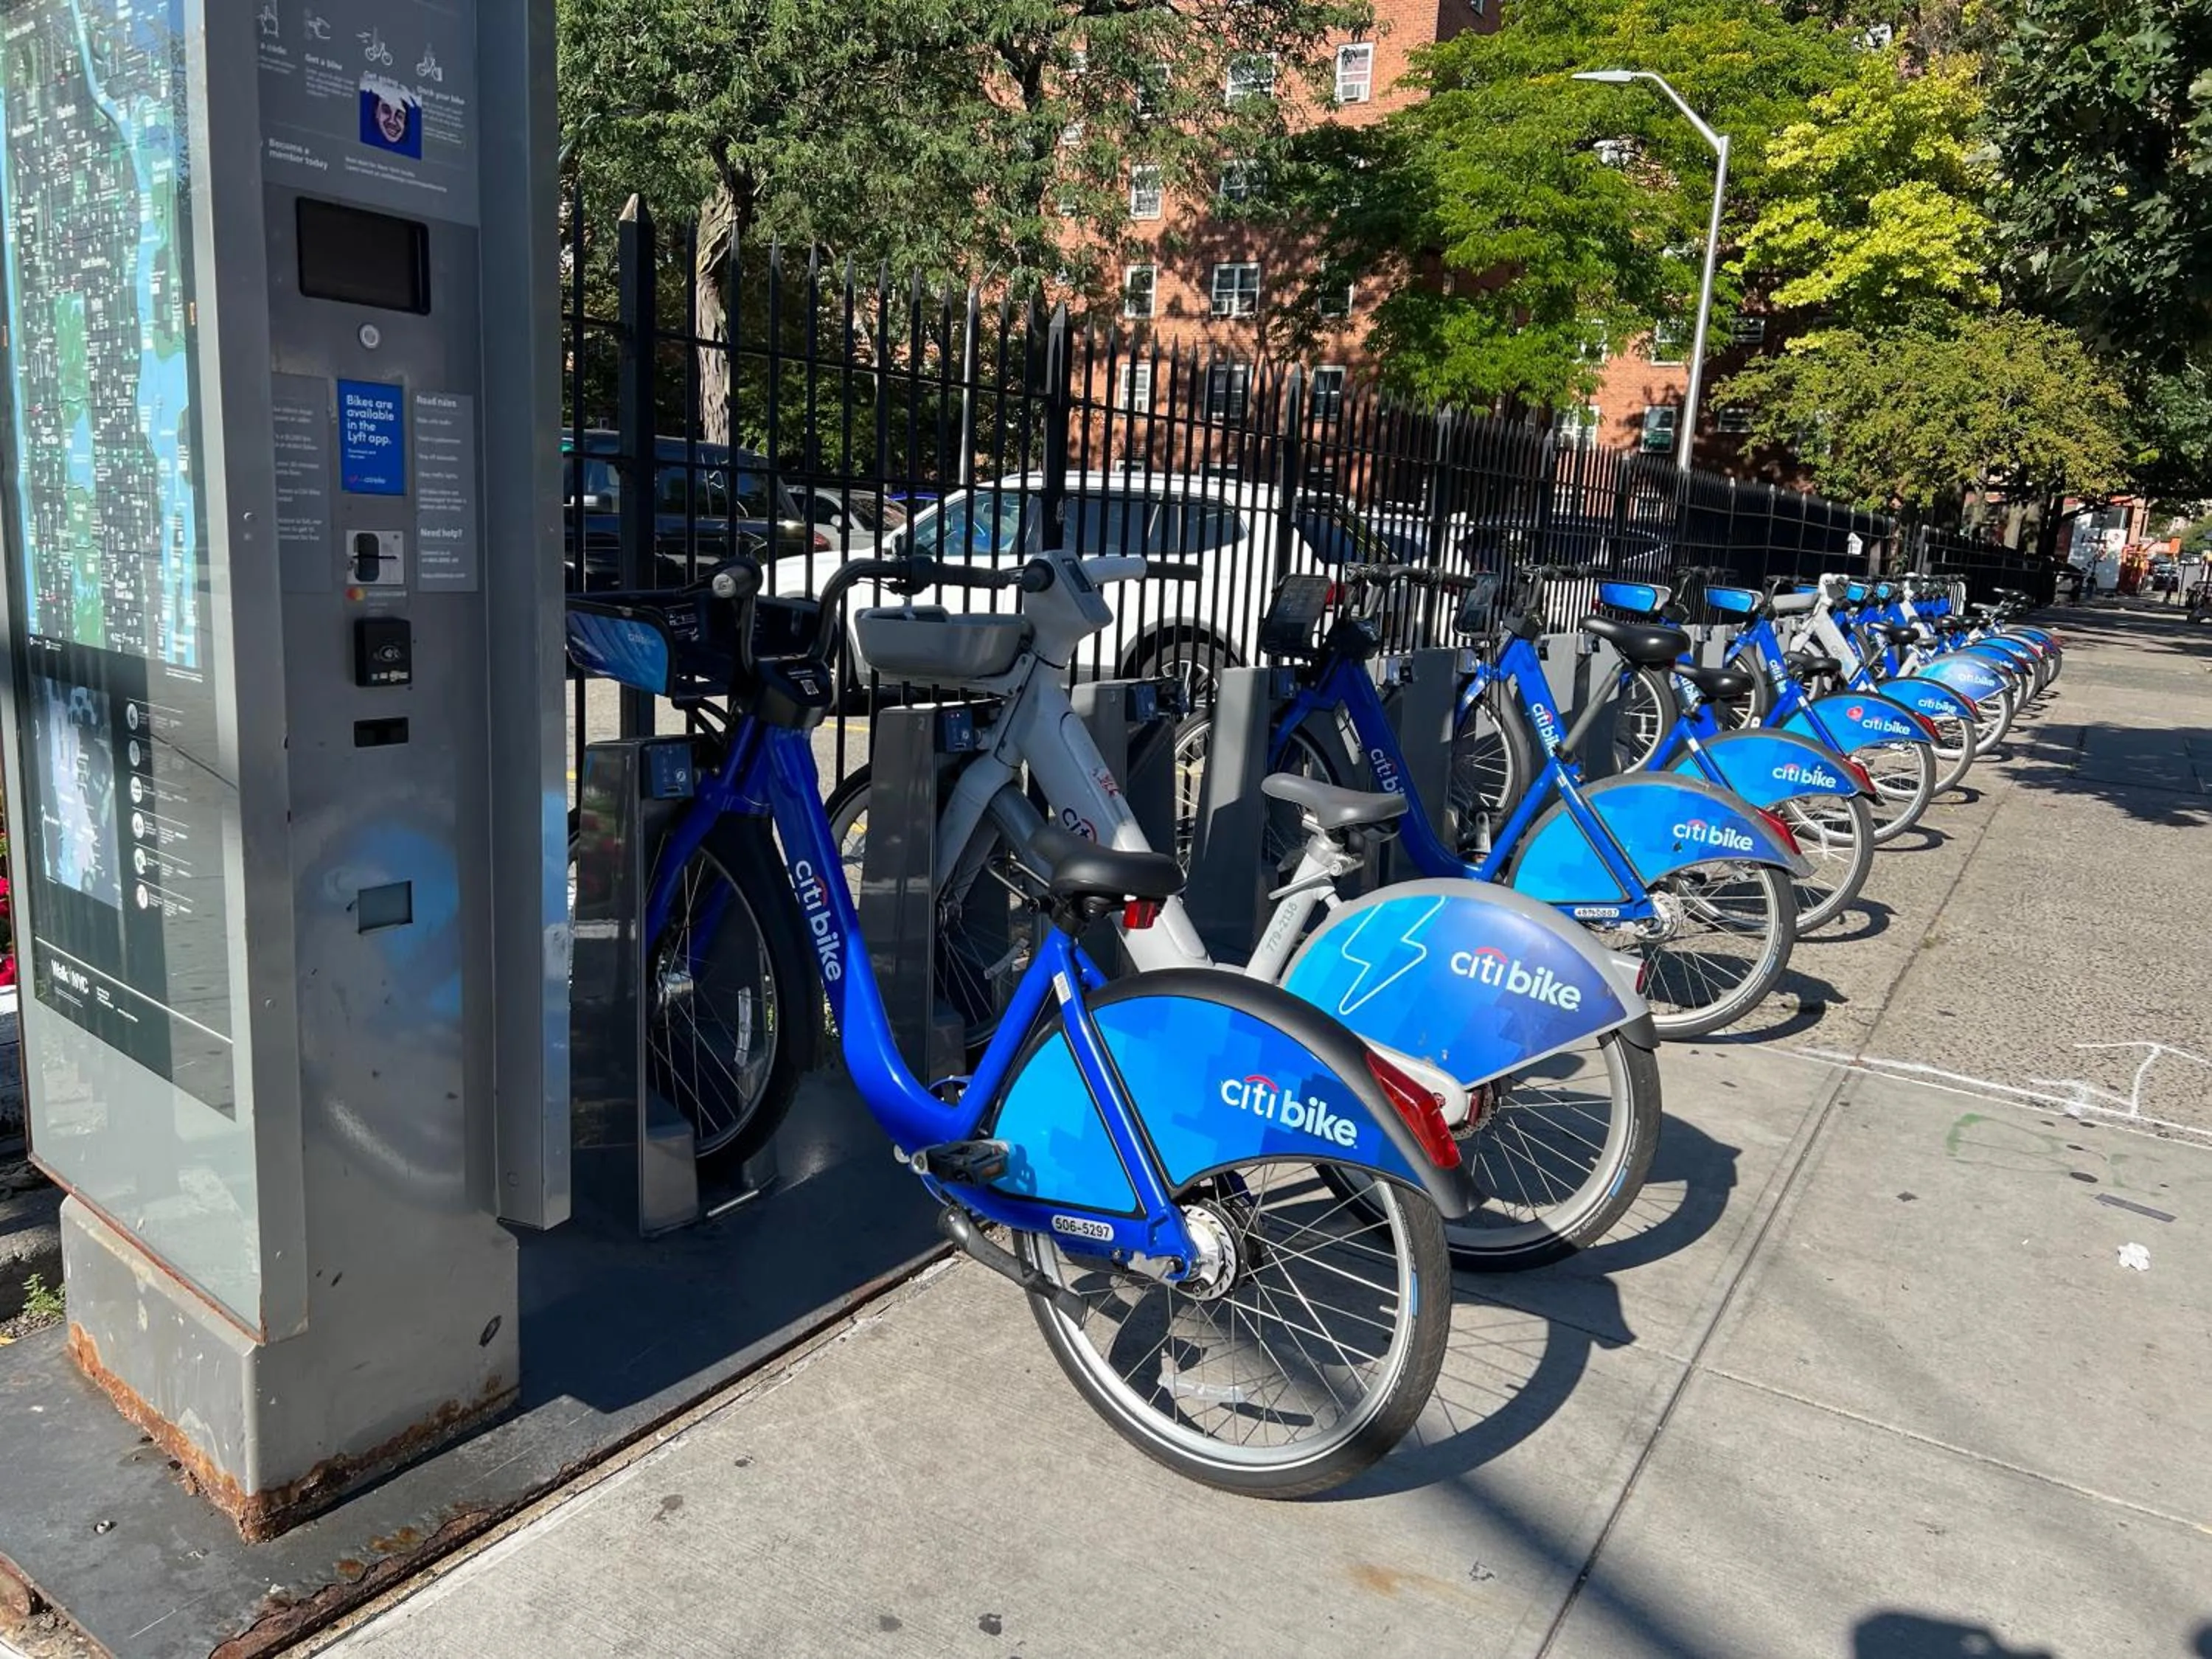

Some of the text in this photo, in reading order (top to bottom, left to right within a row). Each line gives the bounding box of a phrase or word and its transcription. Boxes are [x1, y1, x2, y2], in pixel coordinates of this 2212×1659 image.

[305, 157, 329, 170] today
[347, 394, 393, 410] Bikes are
[347, 408, 394, 421] available
[347, 418, 376, 431] in the
[347, 431, 392, 446] Lyft app.
[420, 527, 463, 540] Need help?
[1533, 703, 1551, 727] citi
[1862, 717, 1911, 735] citi bike
[1773, 764, 1837, 788] citi bike
[1673, 820, 1753, 852] citi bike
[795, 860, 842, 981] citi bike
[1450, 947, 1582, 1012] citi bike
[1220, 1074, 1357, 1147] citi bike
[1055, 1217, 1110, 1239] 506-5297
